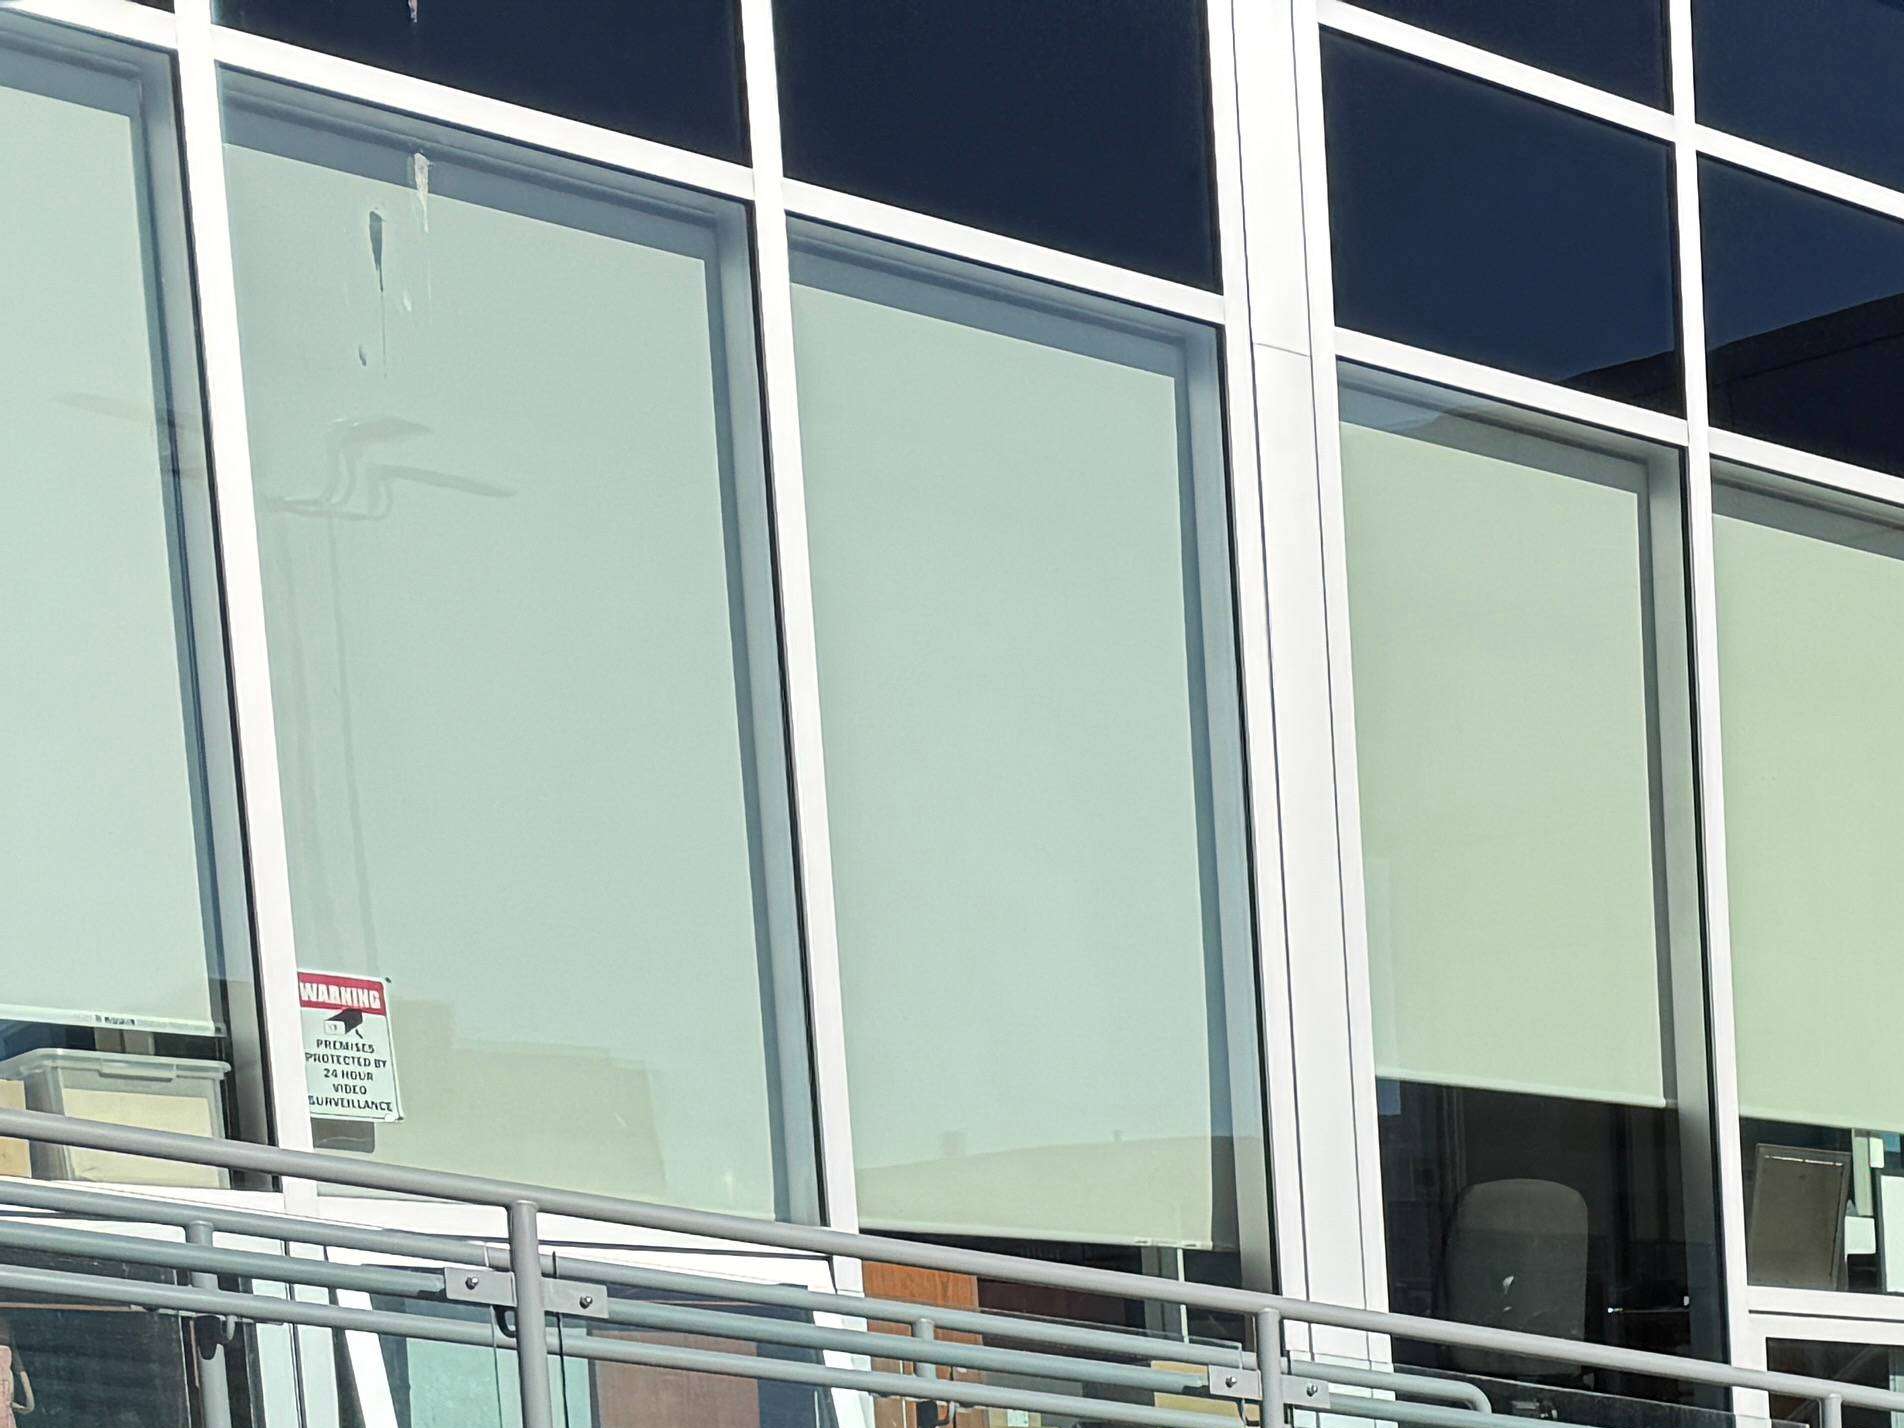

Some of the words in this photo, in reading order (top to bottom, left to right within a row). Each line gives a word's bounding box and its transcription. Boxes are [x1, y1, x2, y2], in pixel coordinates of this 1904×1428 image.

[301, 983, 381, 1009] WARNING
[316, 1039, 375, 1053] PREMISES
[305, 1052, 371, 1067] PROTECTED
[374, 1060, 387, 1068] BY
[323, 1068, 338, 1079] 24
[341, 1070, 374, 1081] HOUR
[333, 1083, 367, 1095] VIDEO
[308, 1095, 393, 1112] SURVEILLANCE
